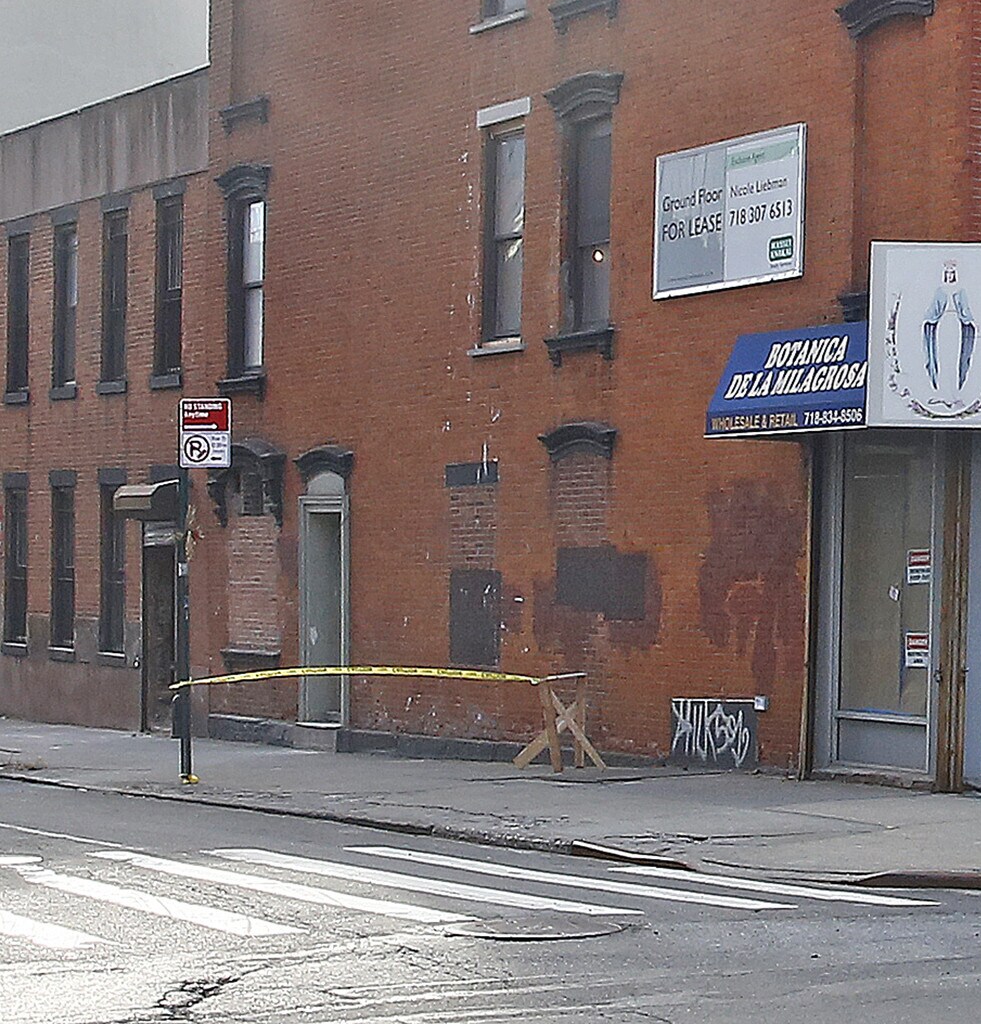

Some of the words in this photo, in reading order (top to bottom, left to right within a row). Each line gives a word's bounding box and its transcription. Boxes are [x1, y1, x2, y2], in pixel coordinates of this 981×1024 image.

[663, 191, 696, 212] Ground
[698, 188, 723, 205] Floor
[730, 183, 755, 198] Nicole
[756, 177, 787, 194] Liebman
[730, 208, 746, 226] 718
[749, 206, 766, 224] 307
[769, 199, 793, 220] 6513
[662, 220, 685, 241] FOR
[688, 213, 723, 237] LEASE
[765, 336, 849, 369] BOTANICA
[724, 372, 752, 399] DE
[749, 370, 773, 396] LA
[770, 360, 868, 395] MILAGROSA
[711, 413, 761, 431] WHOLESALE
[769, 412, 798, 428] RETAIL
